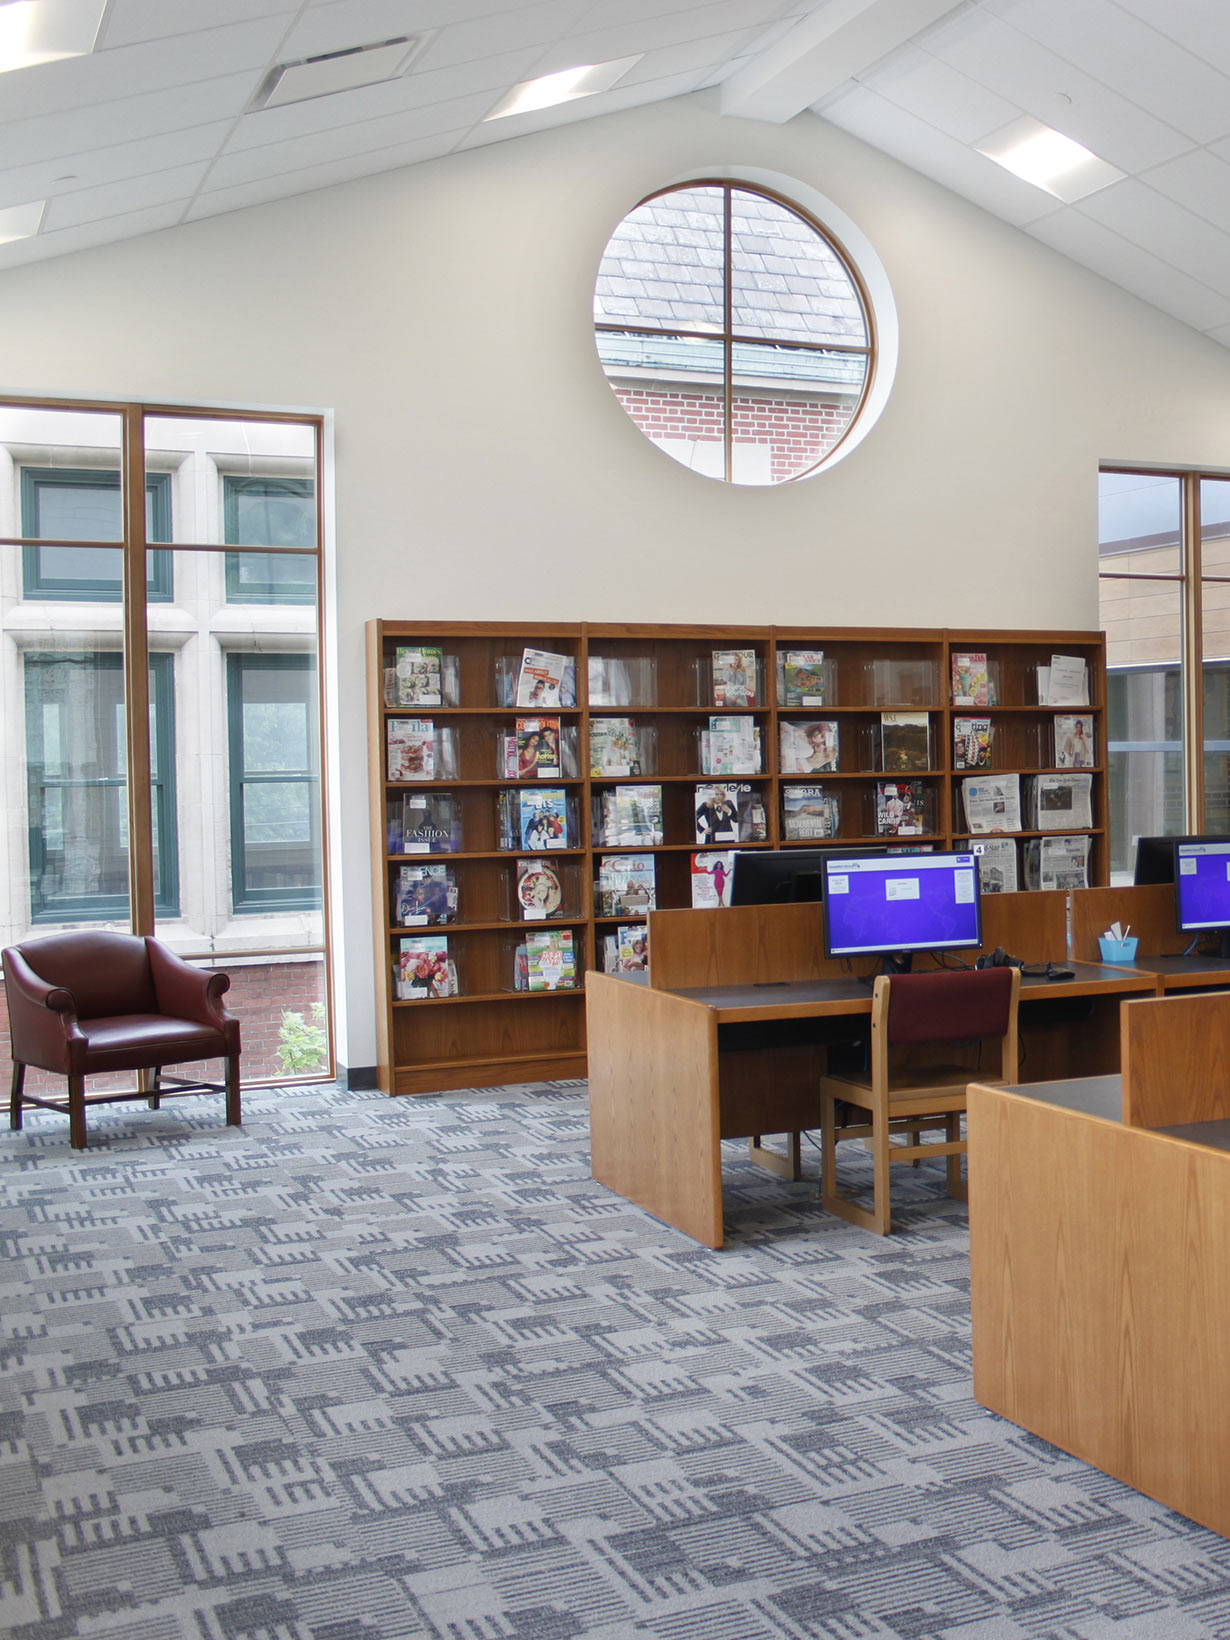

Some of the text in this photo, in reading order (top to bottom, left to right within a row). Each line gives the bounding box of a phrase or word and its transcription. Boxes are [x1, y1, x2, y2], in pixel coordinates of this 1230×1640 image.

[406, 830, 449, 838] FASHION
[976, 846, 983, 854] 4
[401, 864, 446, 878] EENCE
